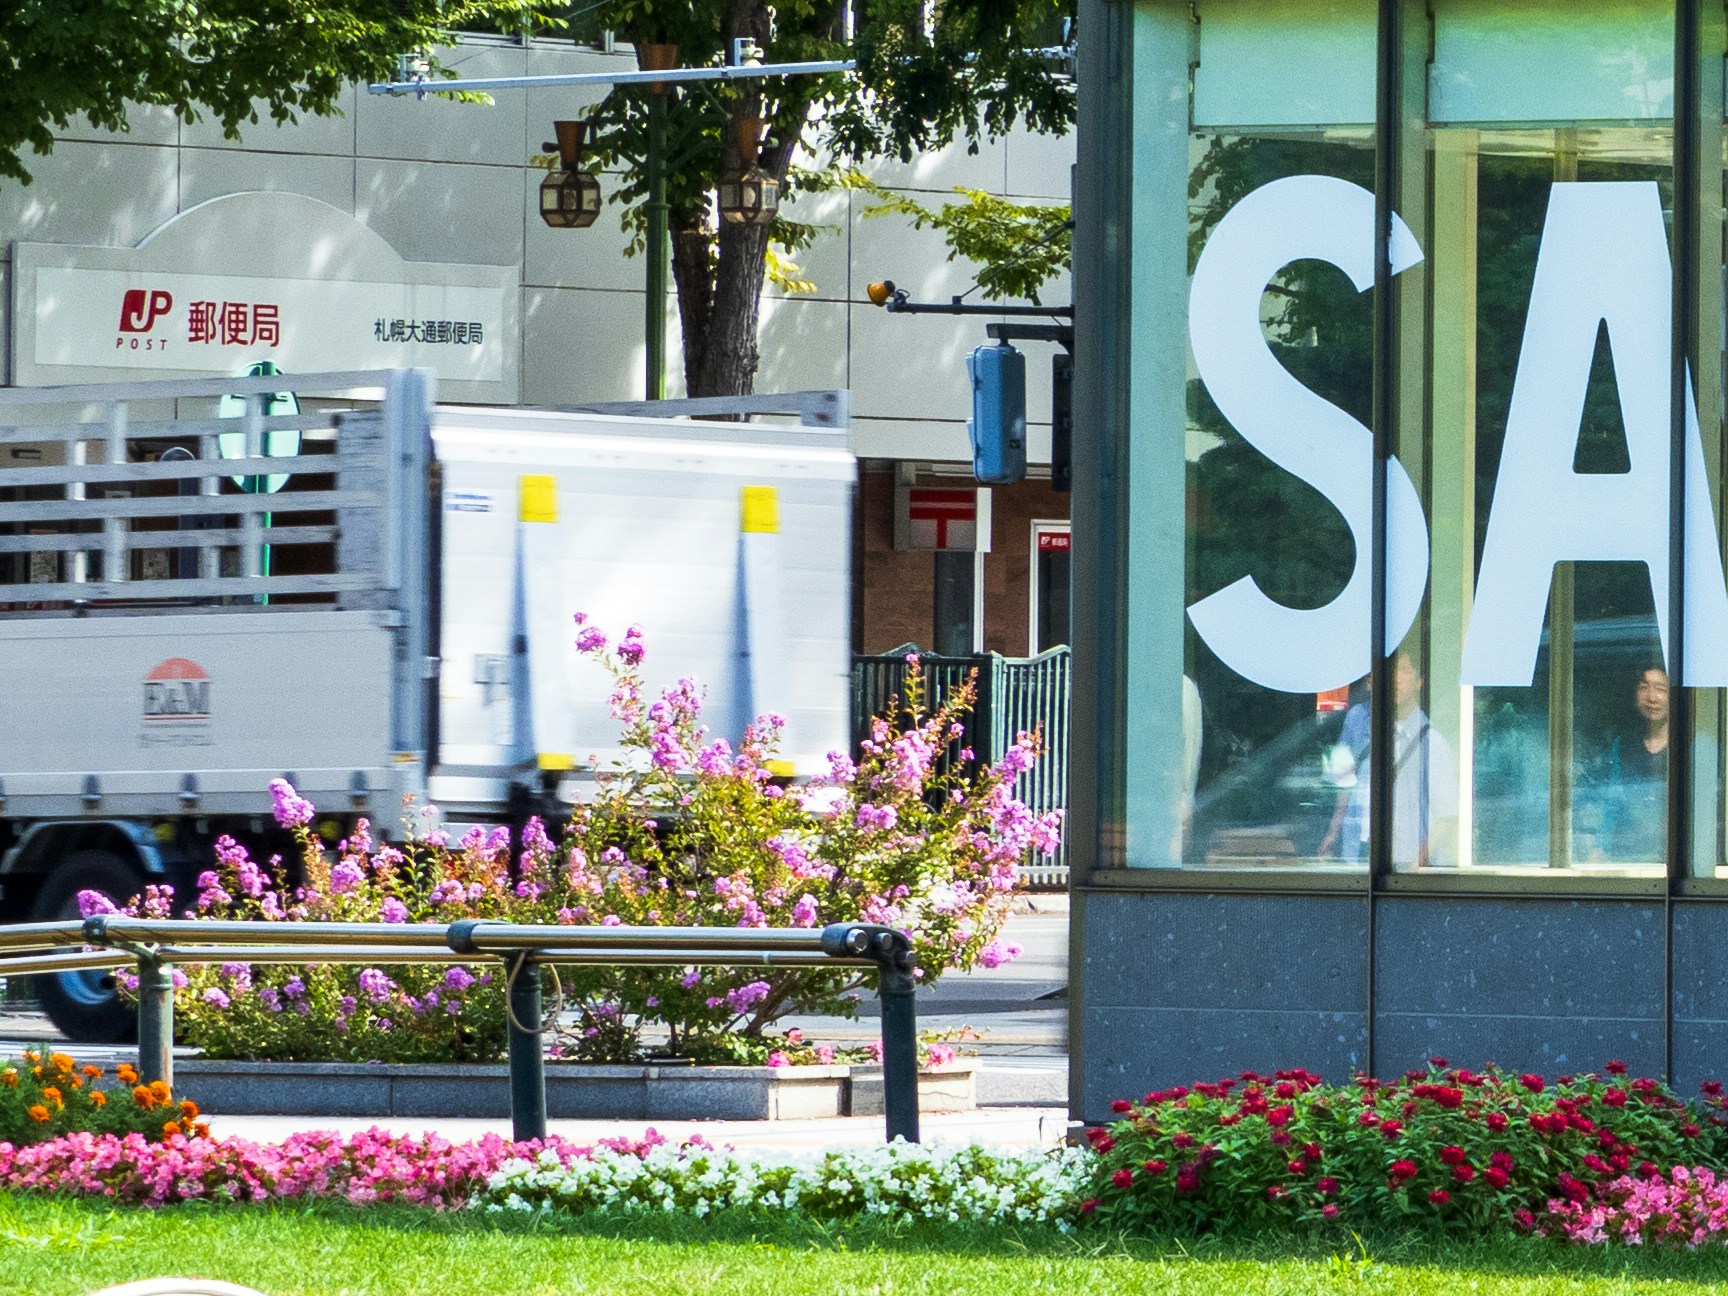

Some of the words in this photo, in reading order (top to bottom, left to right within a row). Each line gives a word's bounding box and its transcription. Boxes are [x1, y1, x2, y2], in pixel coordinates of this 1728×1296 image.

[188, 301, 280, 347] 郵便局
[374, 317, 484, 345] 札幌大通郵便局
[116, 337, 168, 351] POST
